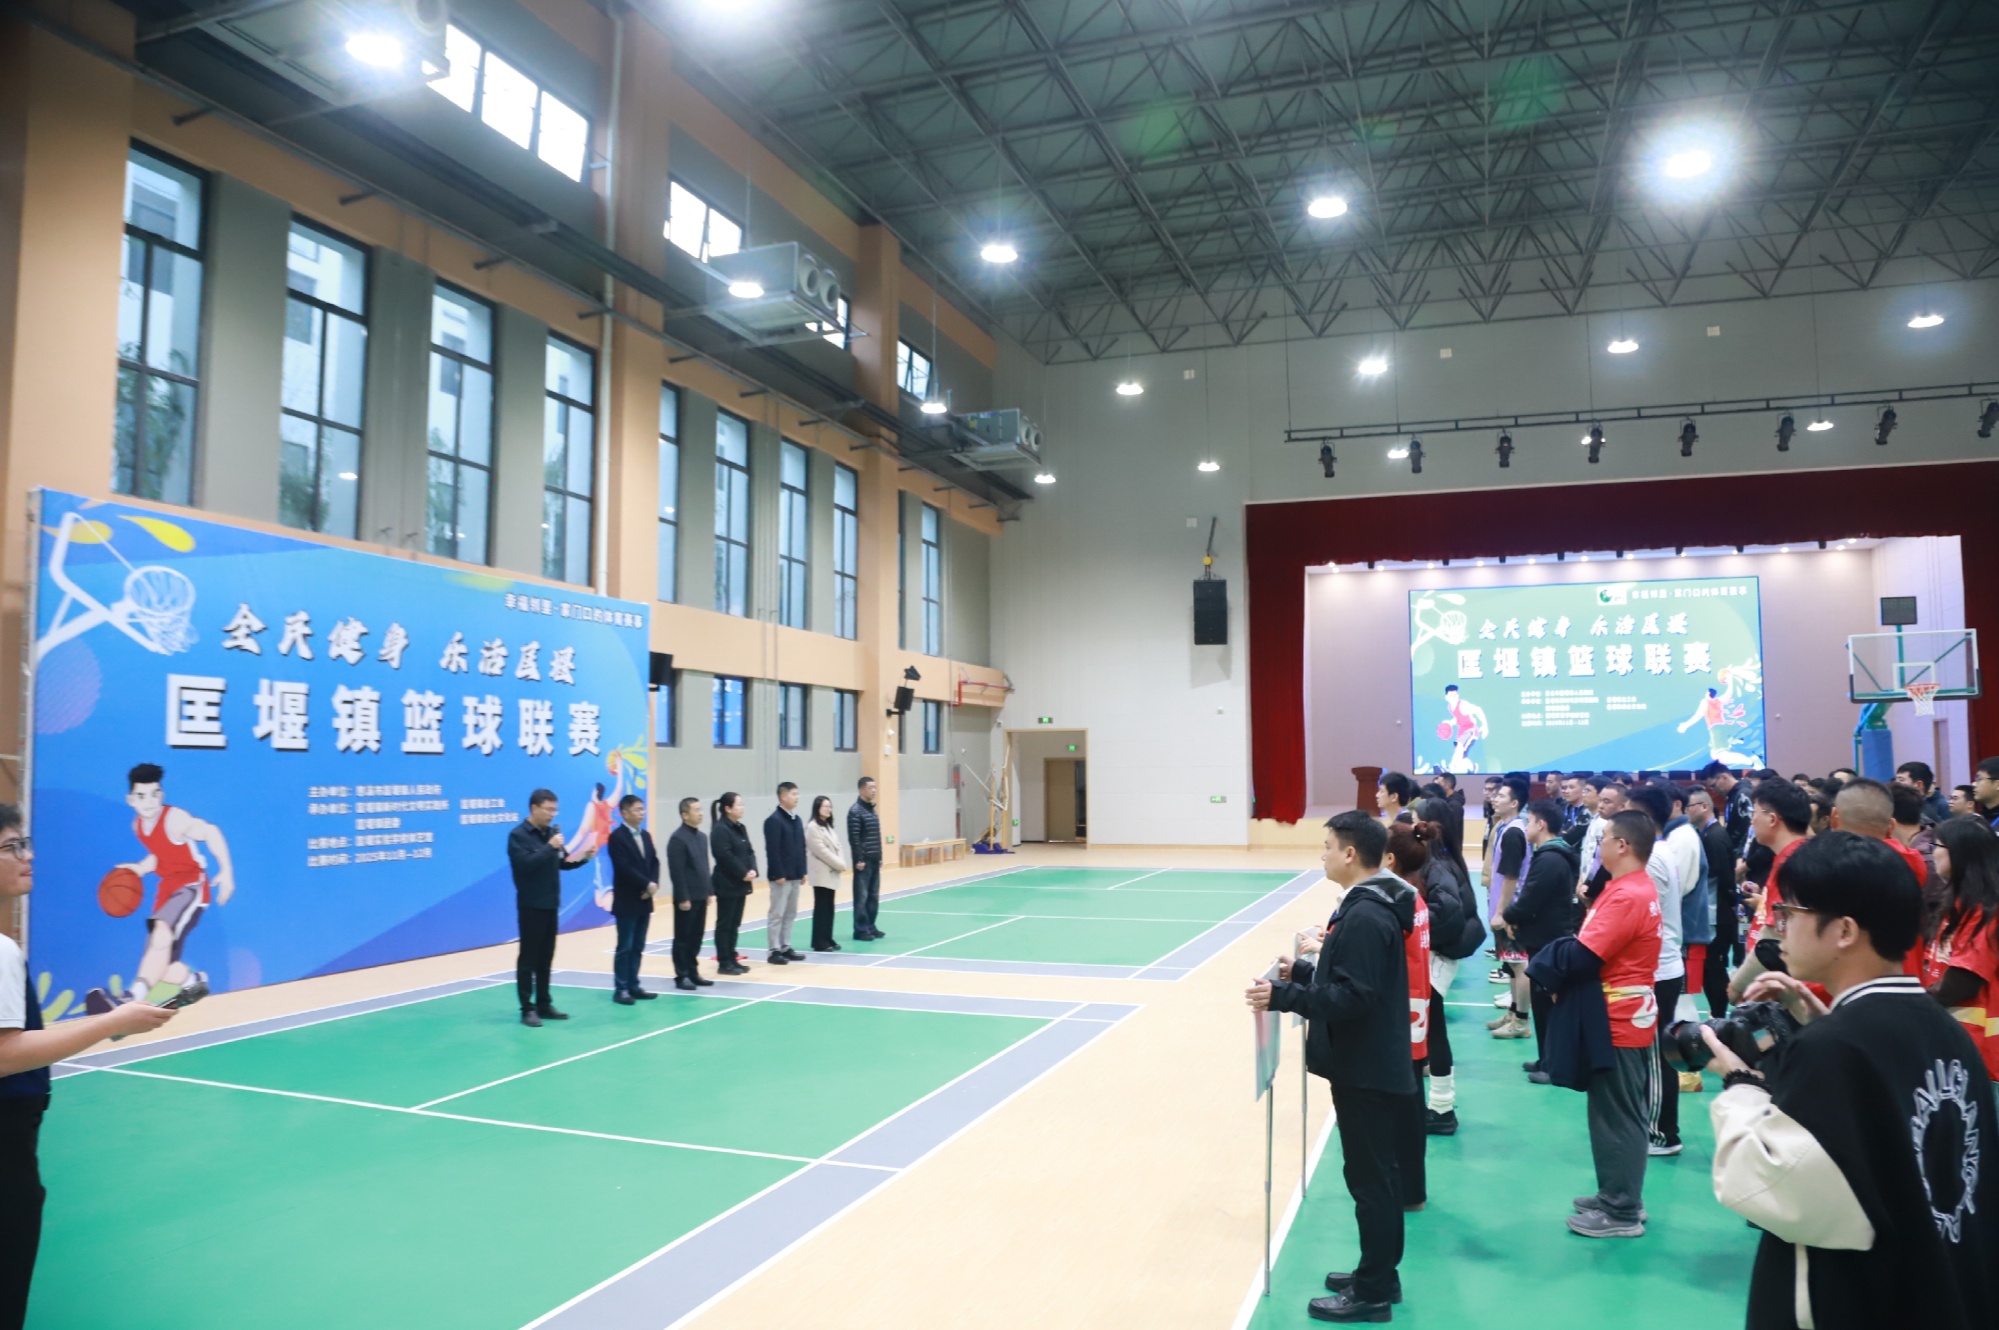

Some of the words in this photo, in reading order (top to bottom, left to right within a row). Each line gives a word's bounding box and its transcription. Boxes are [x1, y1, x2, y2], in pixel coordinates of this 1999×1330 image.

[221, 602, 410, 670] 全民健身
[439, 630, 577, 685] 乐活匡堰
[1478, 615, 1572, 640] 全民健身
[1457, 641, 1712, 679] 匡堰镇篮球联赛
[166, 673, 601, 756] 匡堰镇篮球联赛
